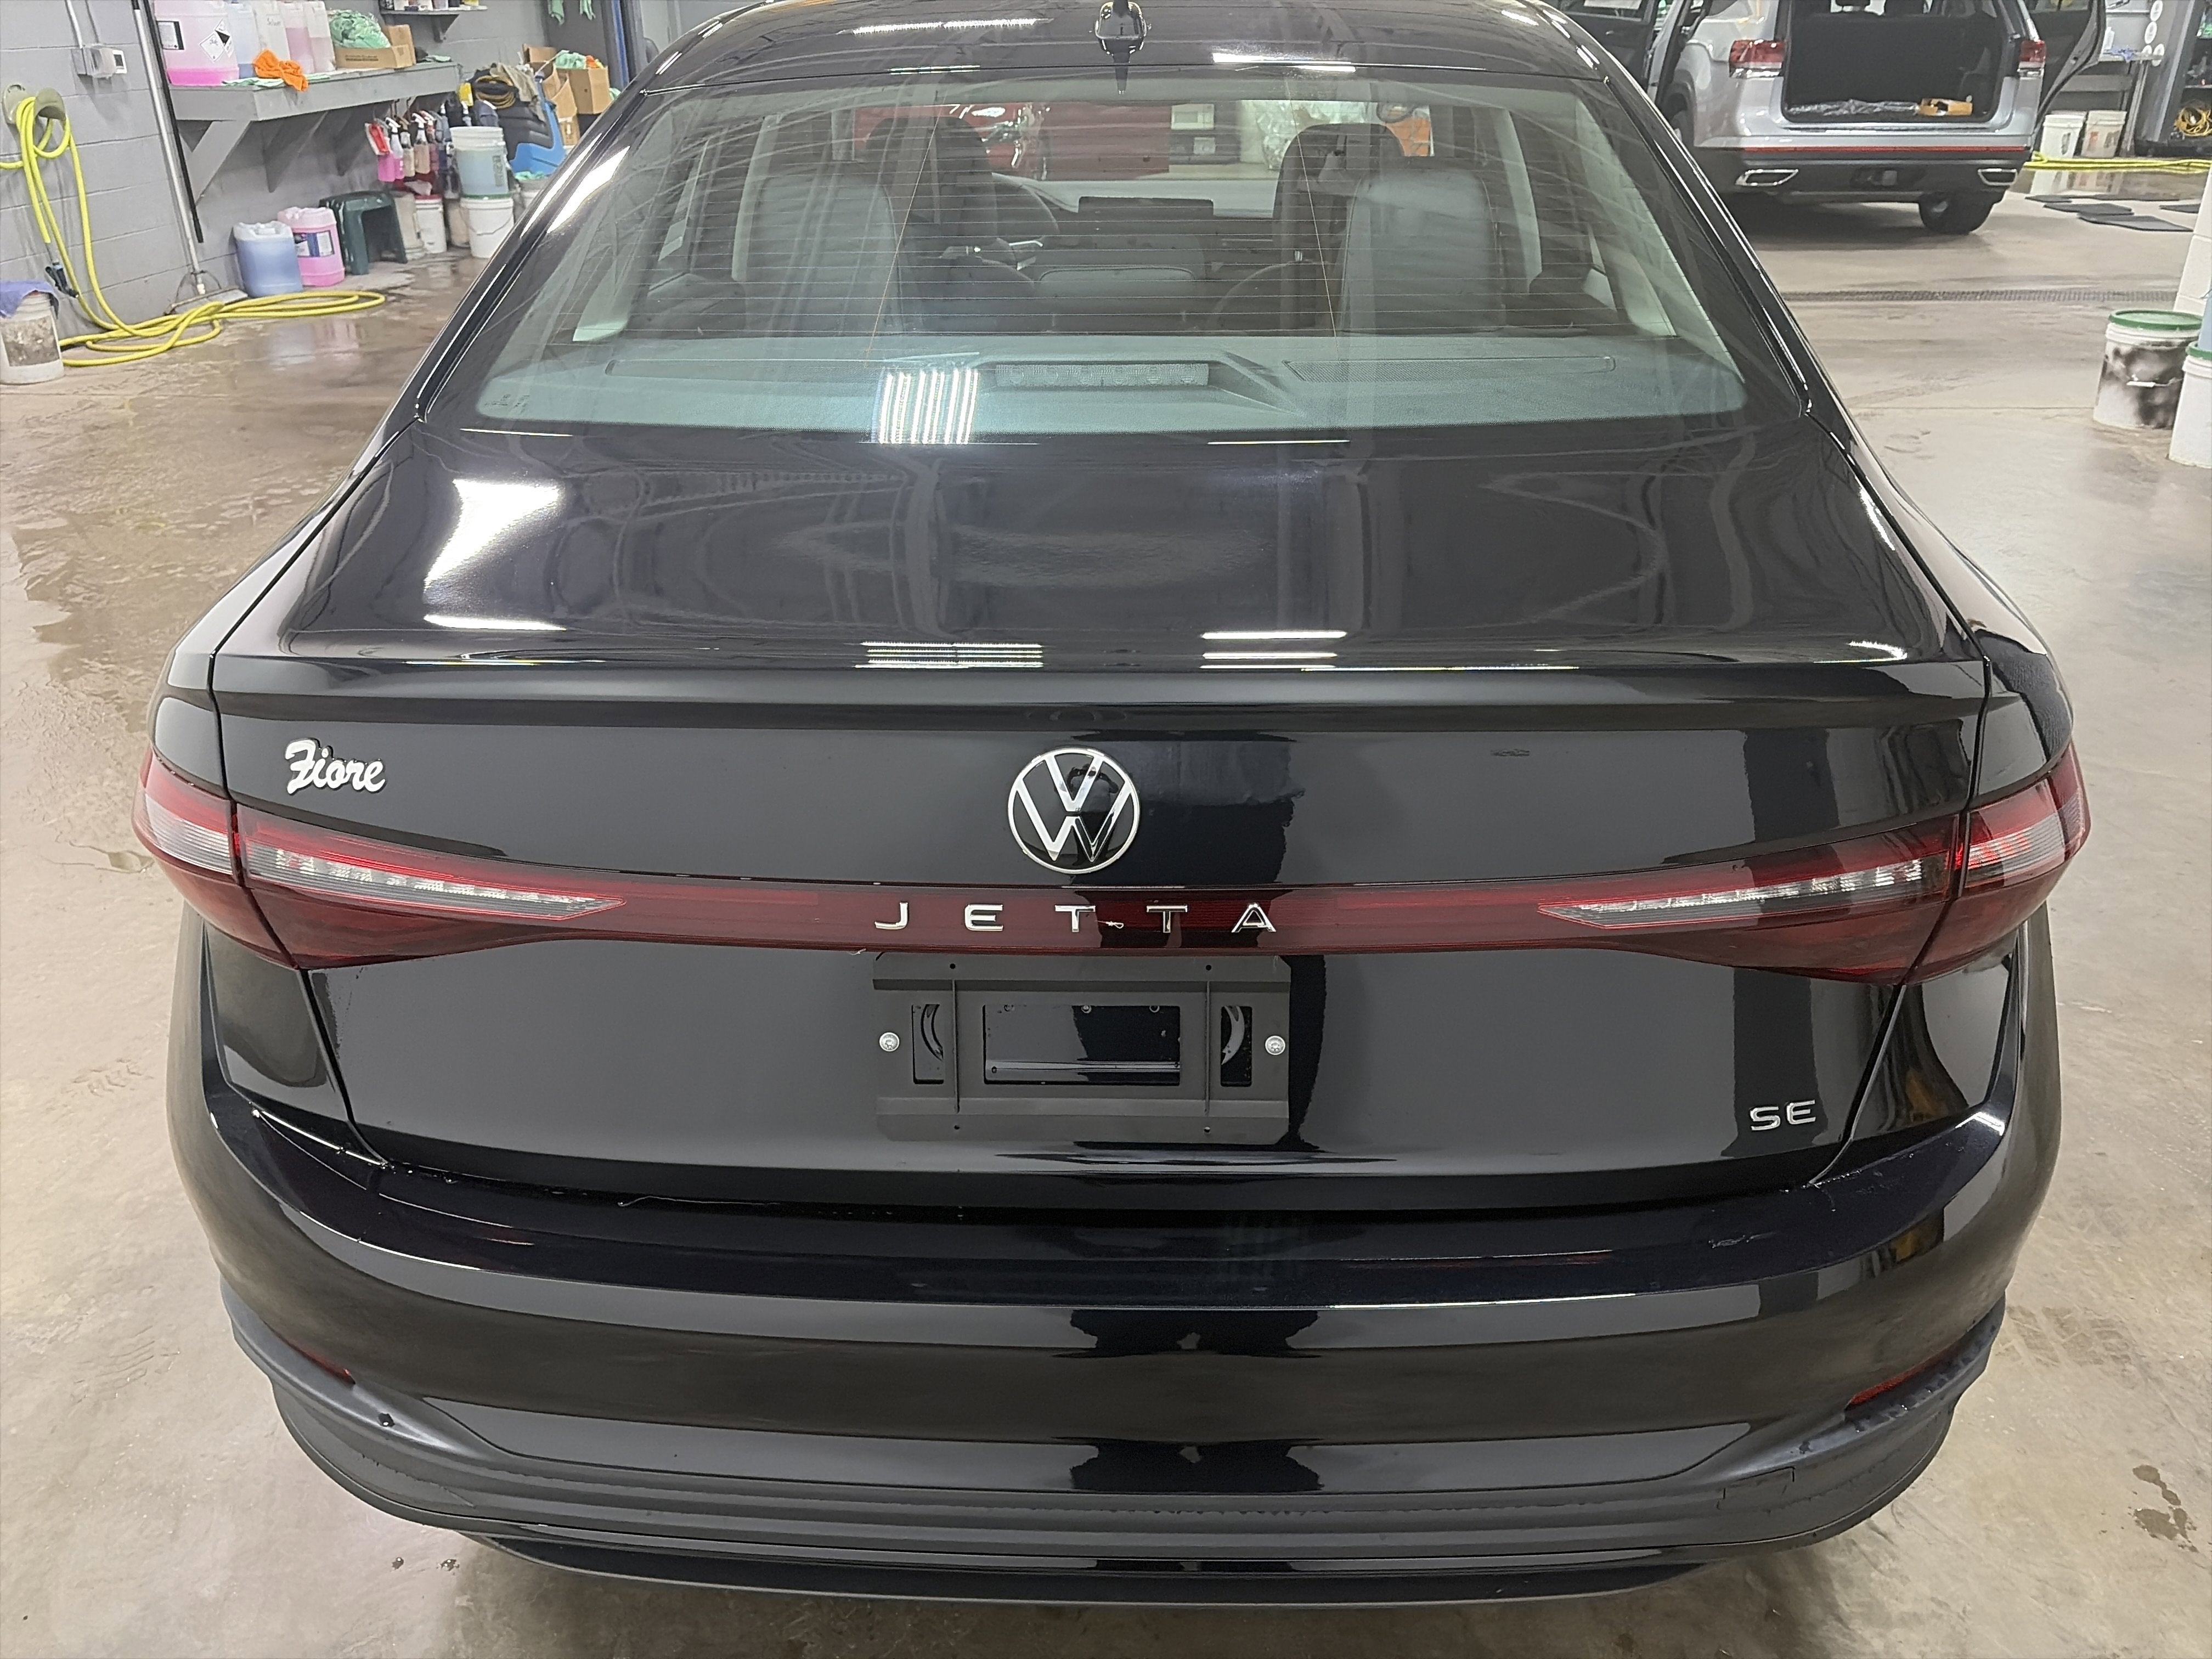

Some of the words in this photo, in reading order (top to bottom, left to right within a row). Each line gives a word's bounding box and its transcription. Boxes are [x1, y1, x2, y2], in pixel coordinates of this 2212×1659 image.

[285, 738, 386, 794] Fiore
[874, 901, 1276, 933] JETTA
[1750, 1099, 1816, 1131] SE
